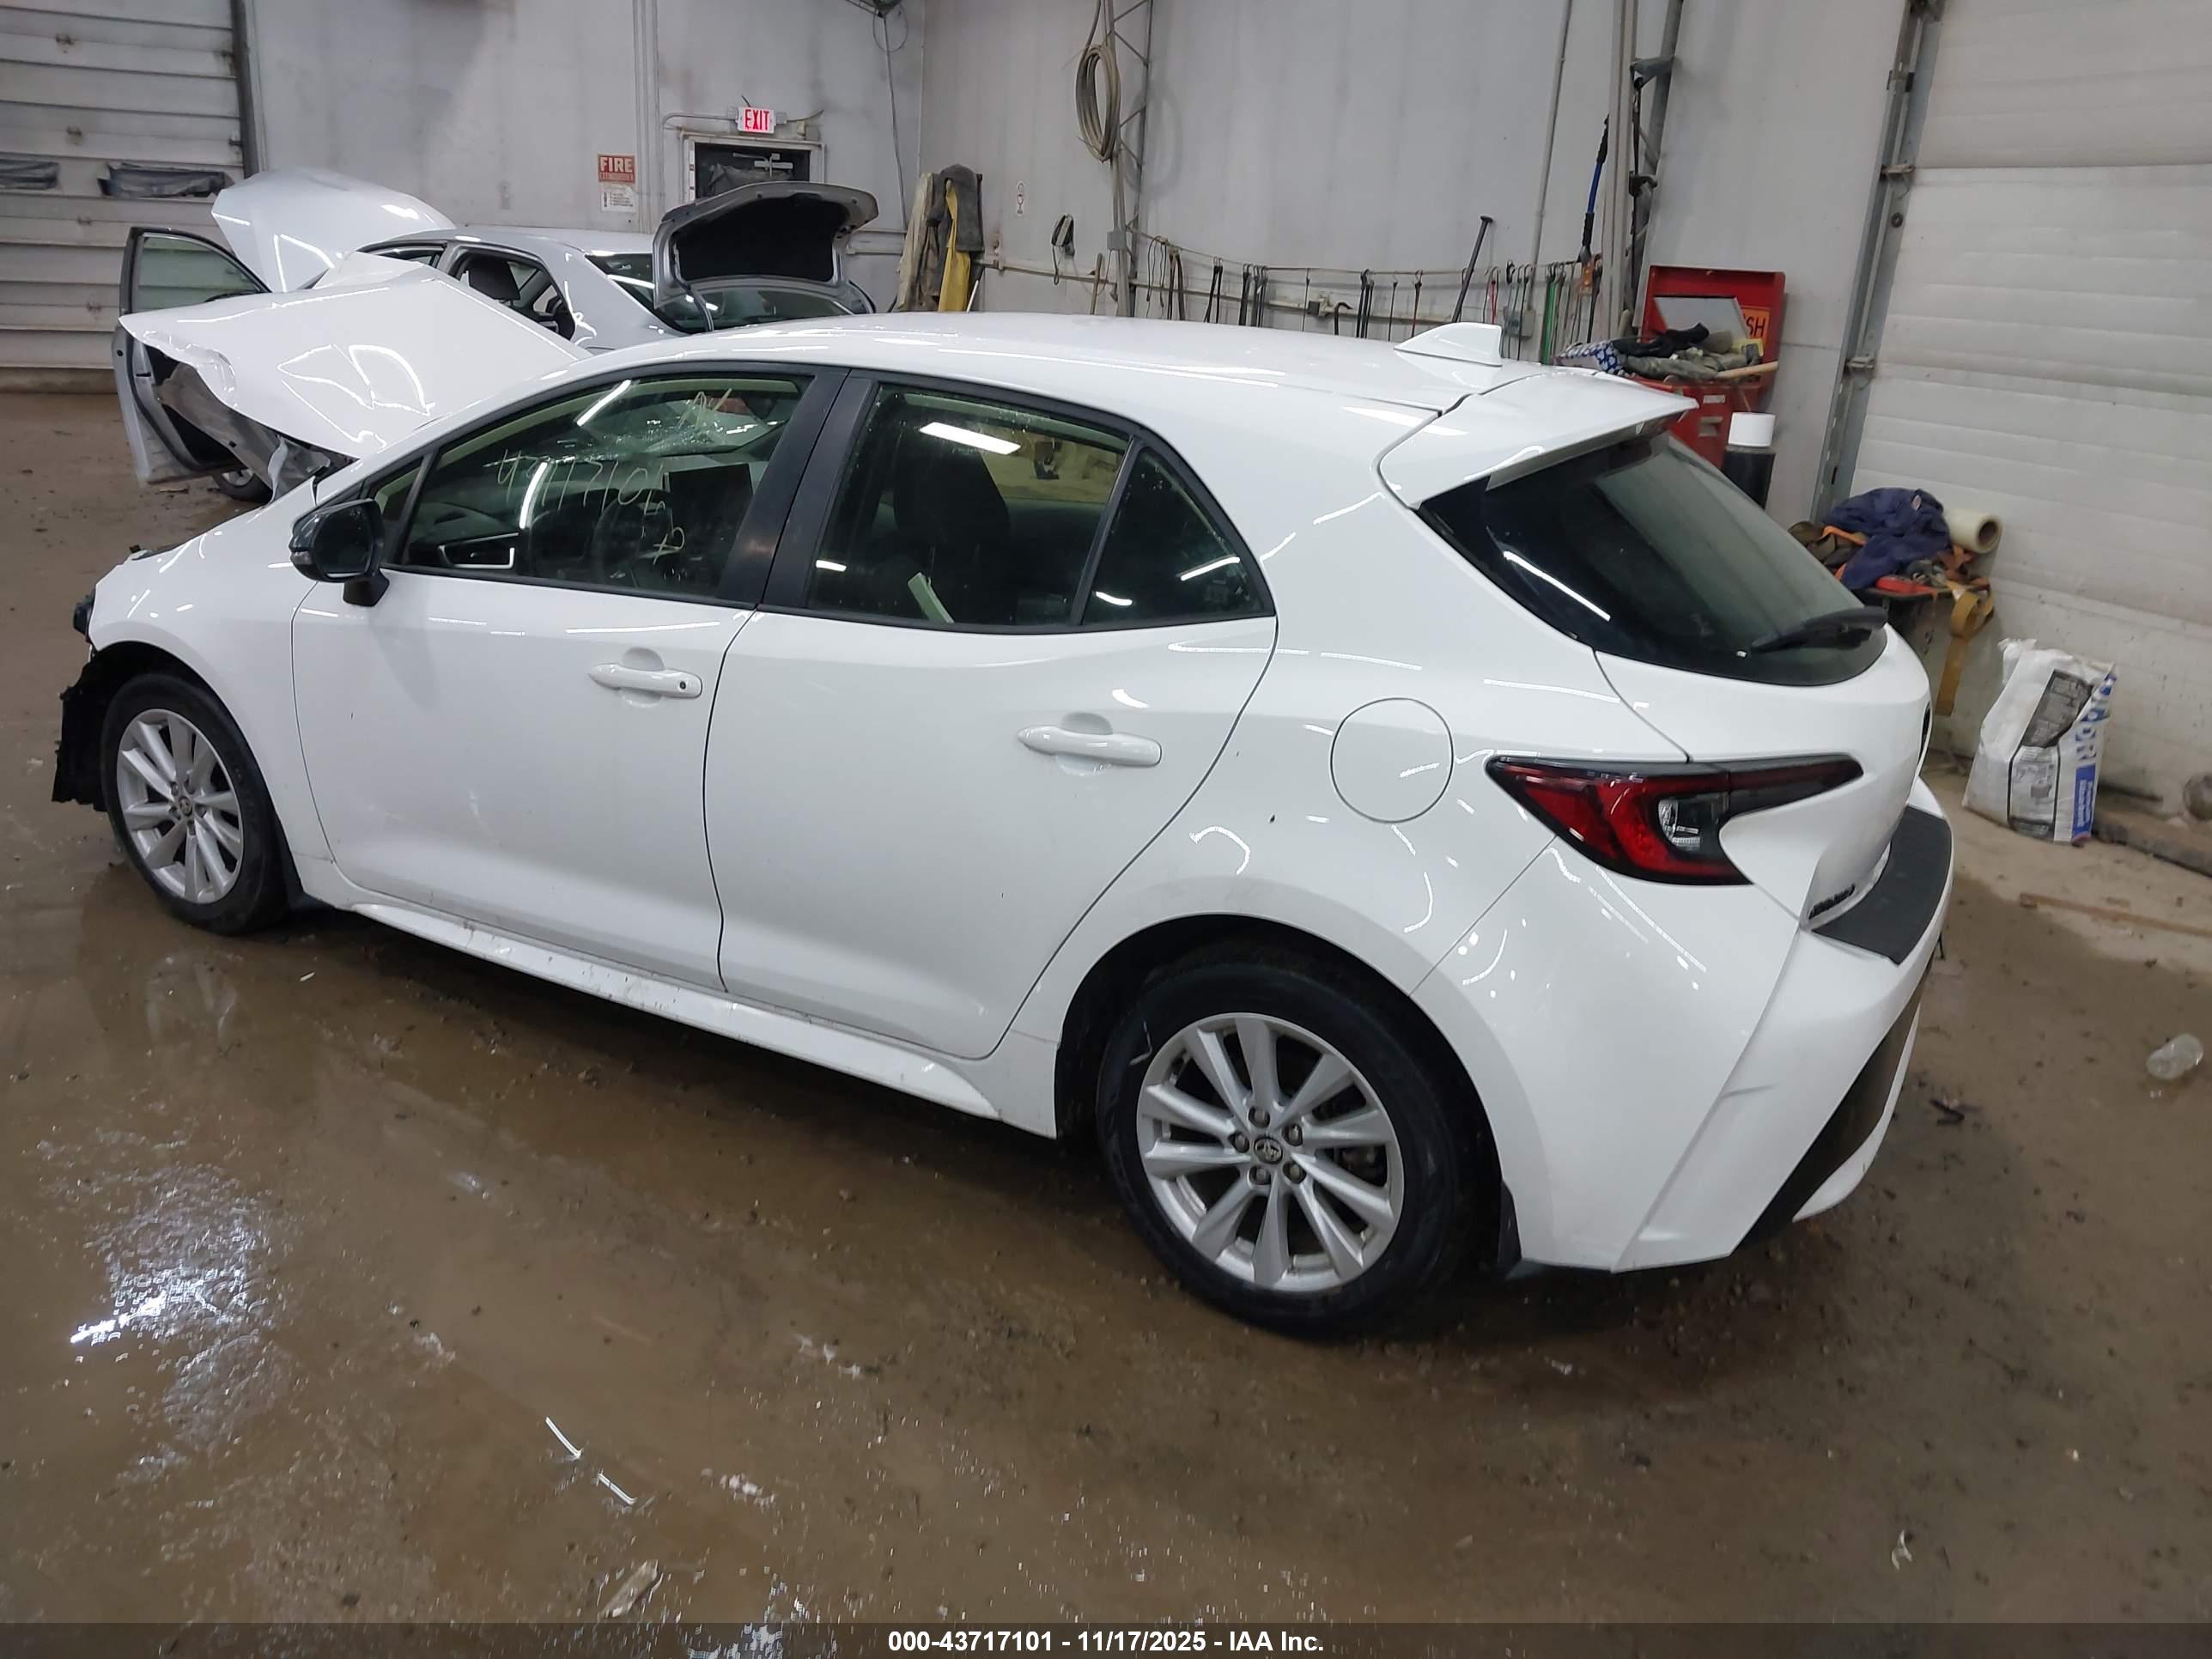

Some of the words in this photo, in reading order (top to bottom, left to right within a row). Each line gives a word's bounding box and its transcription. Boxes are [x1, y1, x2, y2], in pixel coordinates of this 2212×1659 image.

[745, 109, 769, 131] EXIT
[600, 156, 633, 172] FIRE
[1744, 315, 1766, 337] SH
